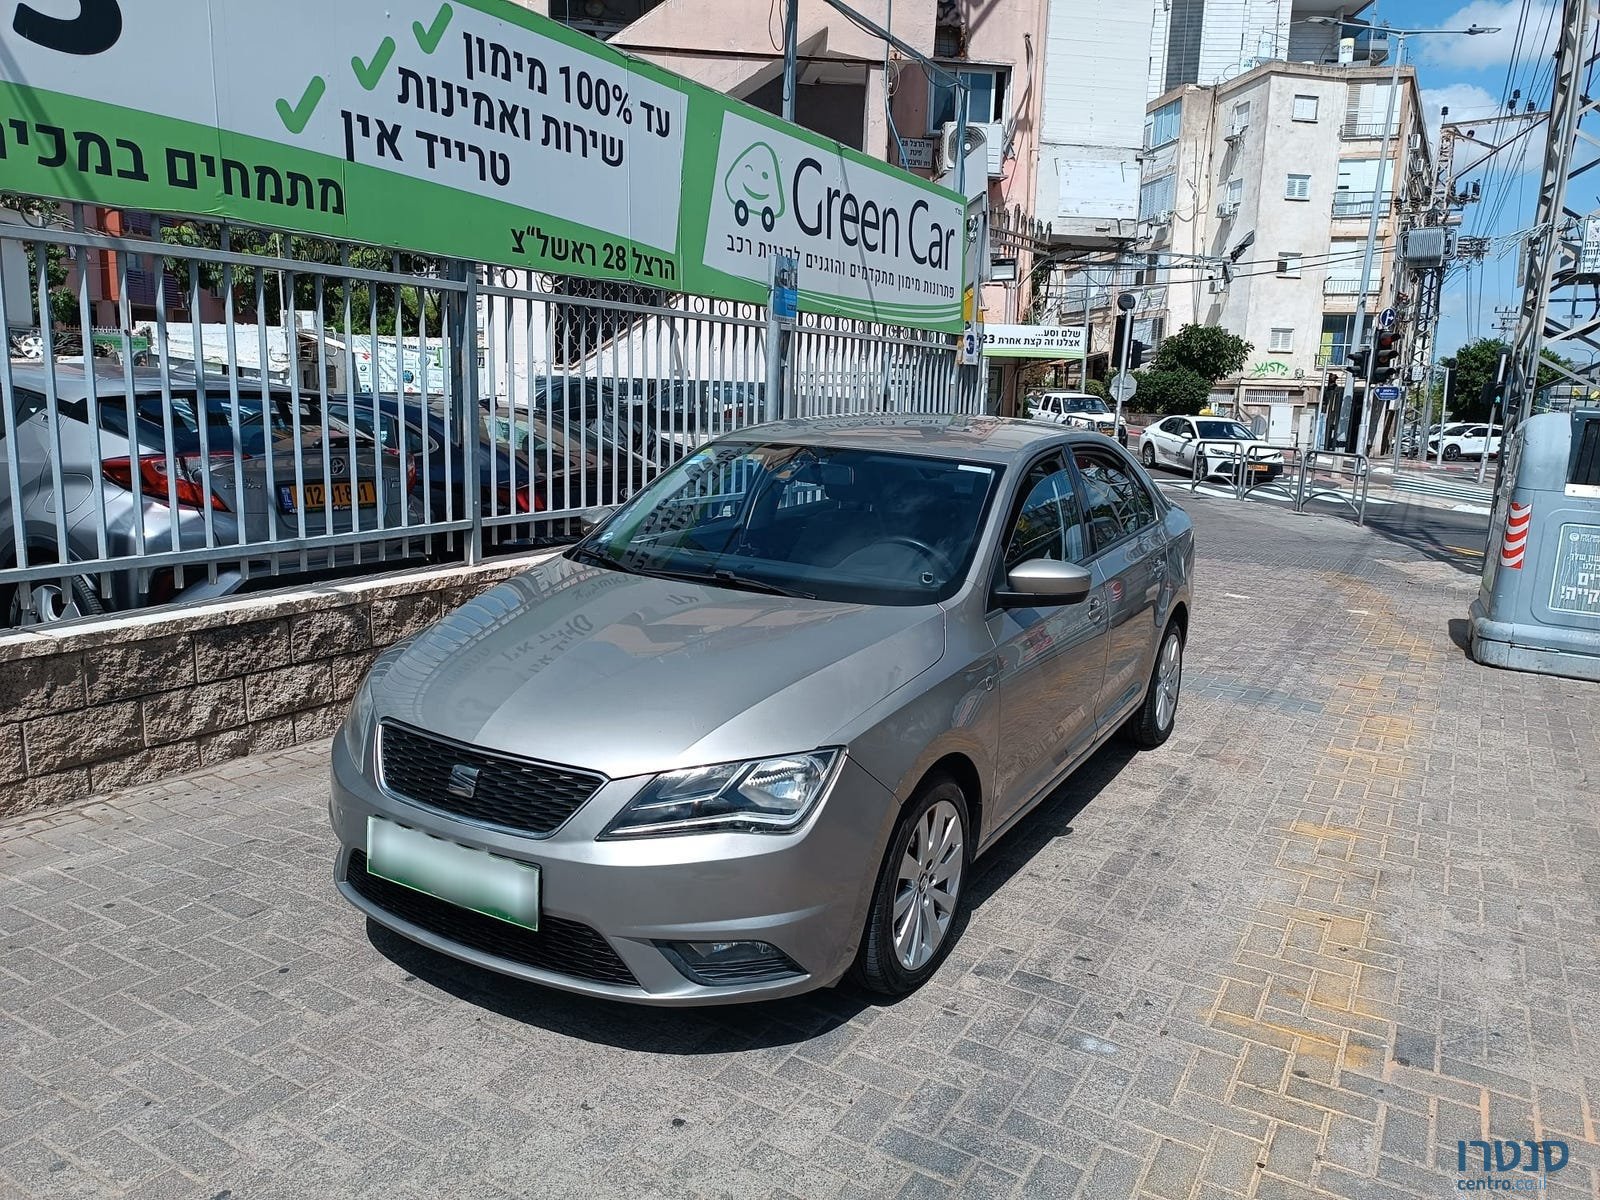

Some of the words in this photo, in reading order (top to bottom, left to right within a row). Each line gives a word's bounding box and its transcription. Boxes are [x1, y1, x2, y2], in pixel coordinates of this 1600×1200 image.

[463, 31, 548, 95] מימון
[397, 66, 531, 141] ואמינות
[559, 66, 633, 125] 100%
[640, 100, 670, 138] עד
[340, 110, 404, 162] אין
[541, 114, 624, 167] שירות
[415, 130, 511, 186] טרייד
[165, 147, 346, 216] מתמחים
[792, 157, 899, 258] Green
[909, 199, 956, 271] Car
[602, 242, 627, 272] 28
[726, 234, 752, 256] רכב
[632, 247, 676, 281] הרצל
[805, 252, 846, 277] והוגנים
[850, 263, 895, 287] מתקדמים
[898, 275, 921, 293] מימון
[923, 281, 955, 299] פתרונות
[998, 337, 1022, 346] אחרת
[1023, 338, 1042, 348] קצת
[1044, 338, 1054, 346] זה
[1056, 338, 1080, 347] אצלנו
[1061, 329, 1081, 338] שלם
